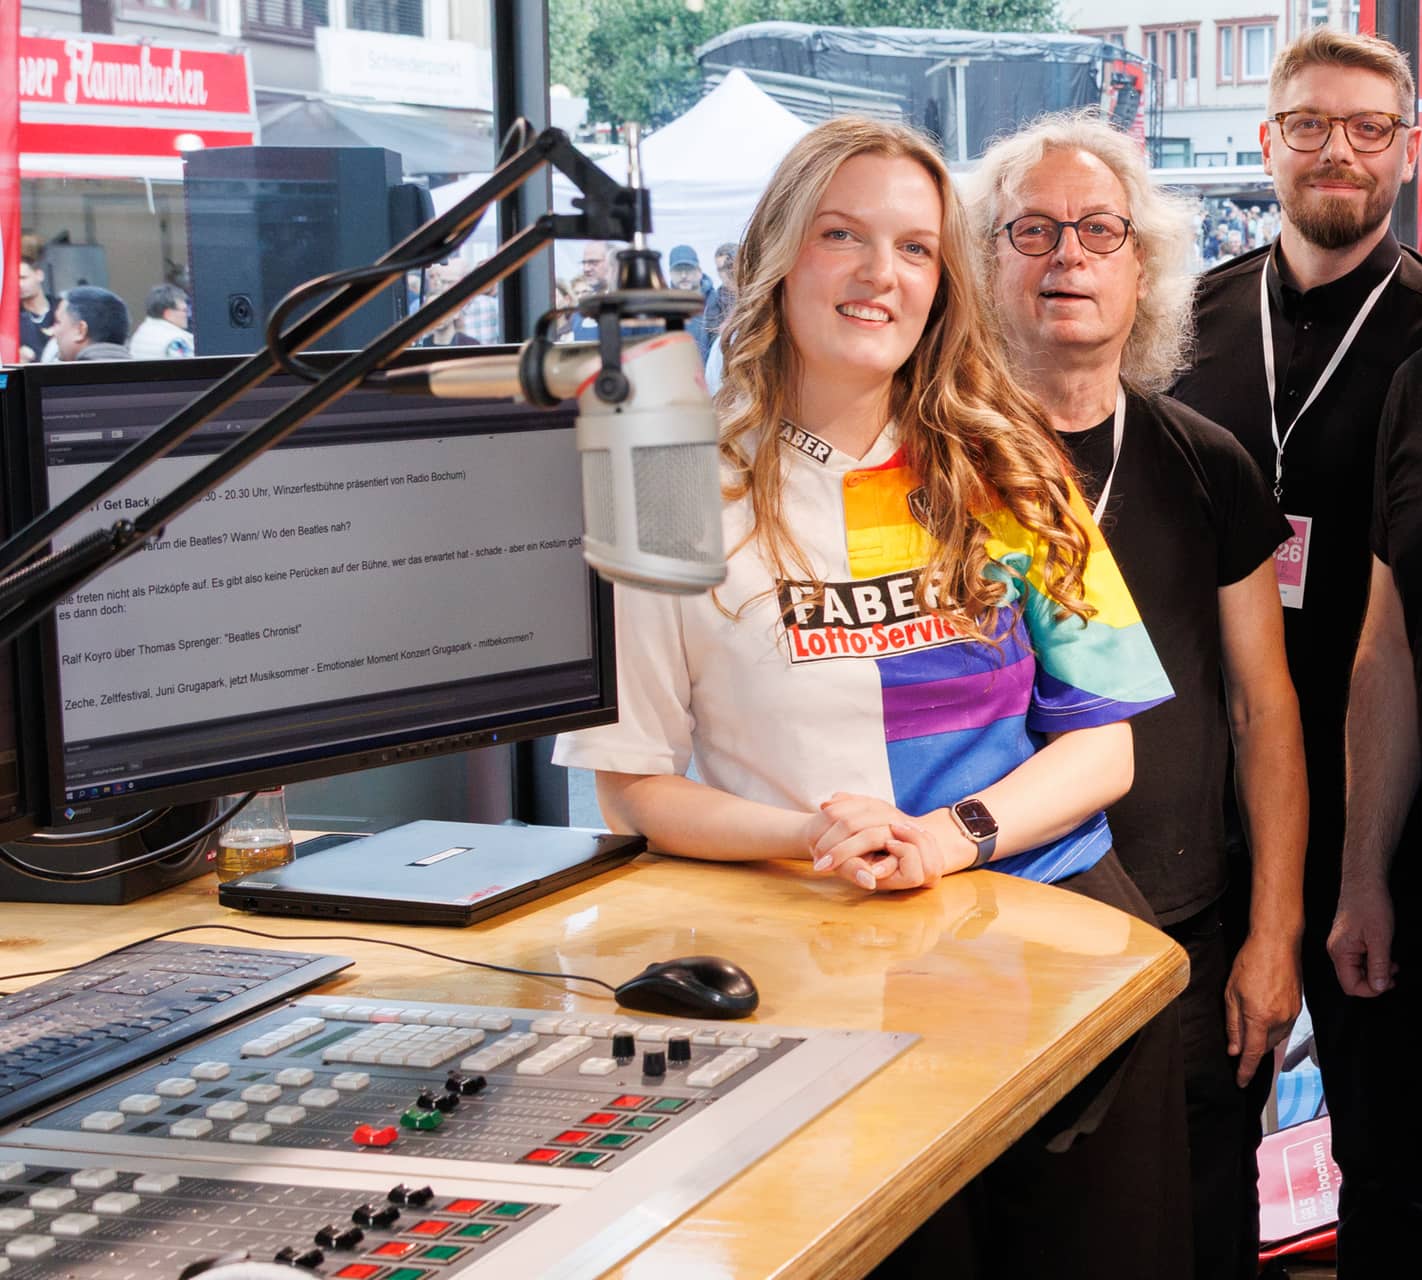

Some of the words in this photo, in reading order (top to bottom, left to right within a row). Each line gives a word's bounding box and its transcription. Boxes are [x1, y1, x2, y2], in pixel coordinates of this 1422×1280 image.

[64, 39, 208, 105] Flammkuchen
[103, 500, 122, 511] Get
[125, 497, 150, 509] Back
[224, 488, 250, 500] 20.30
[273, 481, 344, 496] Winzerfestbühne
[346, 477, 388, 492] präsentiert
[390, 476, 404, 486] von
[406, 473, 430, 483] Radio
[431, 470, 466, 483] Bochum)
[142, 541, 171, 552] arum
[173, 537, 187, 549] die
[189, 533, 228, 547] Beatles?
[261, 528, 277, 539] Wo
[279, 526, 296, 538] den
[298, 523, 328, 536] Beatles
[330, 521, 351, 533] nah?
[1272, 543, 1302, 563] 26
[76, 591, 104, 604] treten
[106, 588, 130, 601] nicht
[132, 586, 146, 598] als
[148, 581, 190, 597] Pilzköpfe
[212, 577, 225, 589] Es
[226, 575, 243, 589] gibt
[244, 573, 263, 584] also
[265, 570, 288, 582] keine
[290, 566, 329, 580] Perücken
[331, 563, 345, 574] auf
[346, 562, 360, 572] der
[391, 557, 406, 567] wer
[408, 555, 422, 565] das
[424, 551, 455, 563] erwartet
[457, 549, 469, 560] hat
[475, 547, 502, 558] schade
[509, 544, 526, 555] aber
[527, 541, 538, 552] ein
[539, 538, 566, 550] Kostüm
[568, 537, 582, 549] gibt
[59, 611, 71, 621] es
[74, 607, 97, 619] dann
[62, 654, 82, 665] Ralf
[85, 650, 112, 665] Koyro
[114, 646, 135, 659] über
[138, 642, 176, 656] Thomas
[178, 636, 222, 652] Sprenger:
[64, 697, 98, 711] Zeche,
[155, 685, 176, 697] Juni
[177, 677, 227, 695] Grugapark,
[229, 674, 249, 689] jetzt
[250, 665, 310, 683] Musiksommer
[317, 657, 365, 673] Emotionaler
[366, 652, 399, 665] Moment
[400, 647, 431, 660] Konzert
[432, 641, 472, 657] Grugapark
[479, 631, 535, 648] mitbekommen?
[1313, 1142, 1332, 1191] bochum
